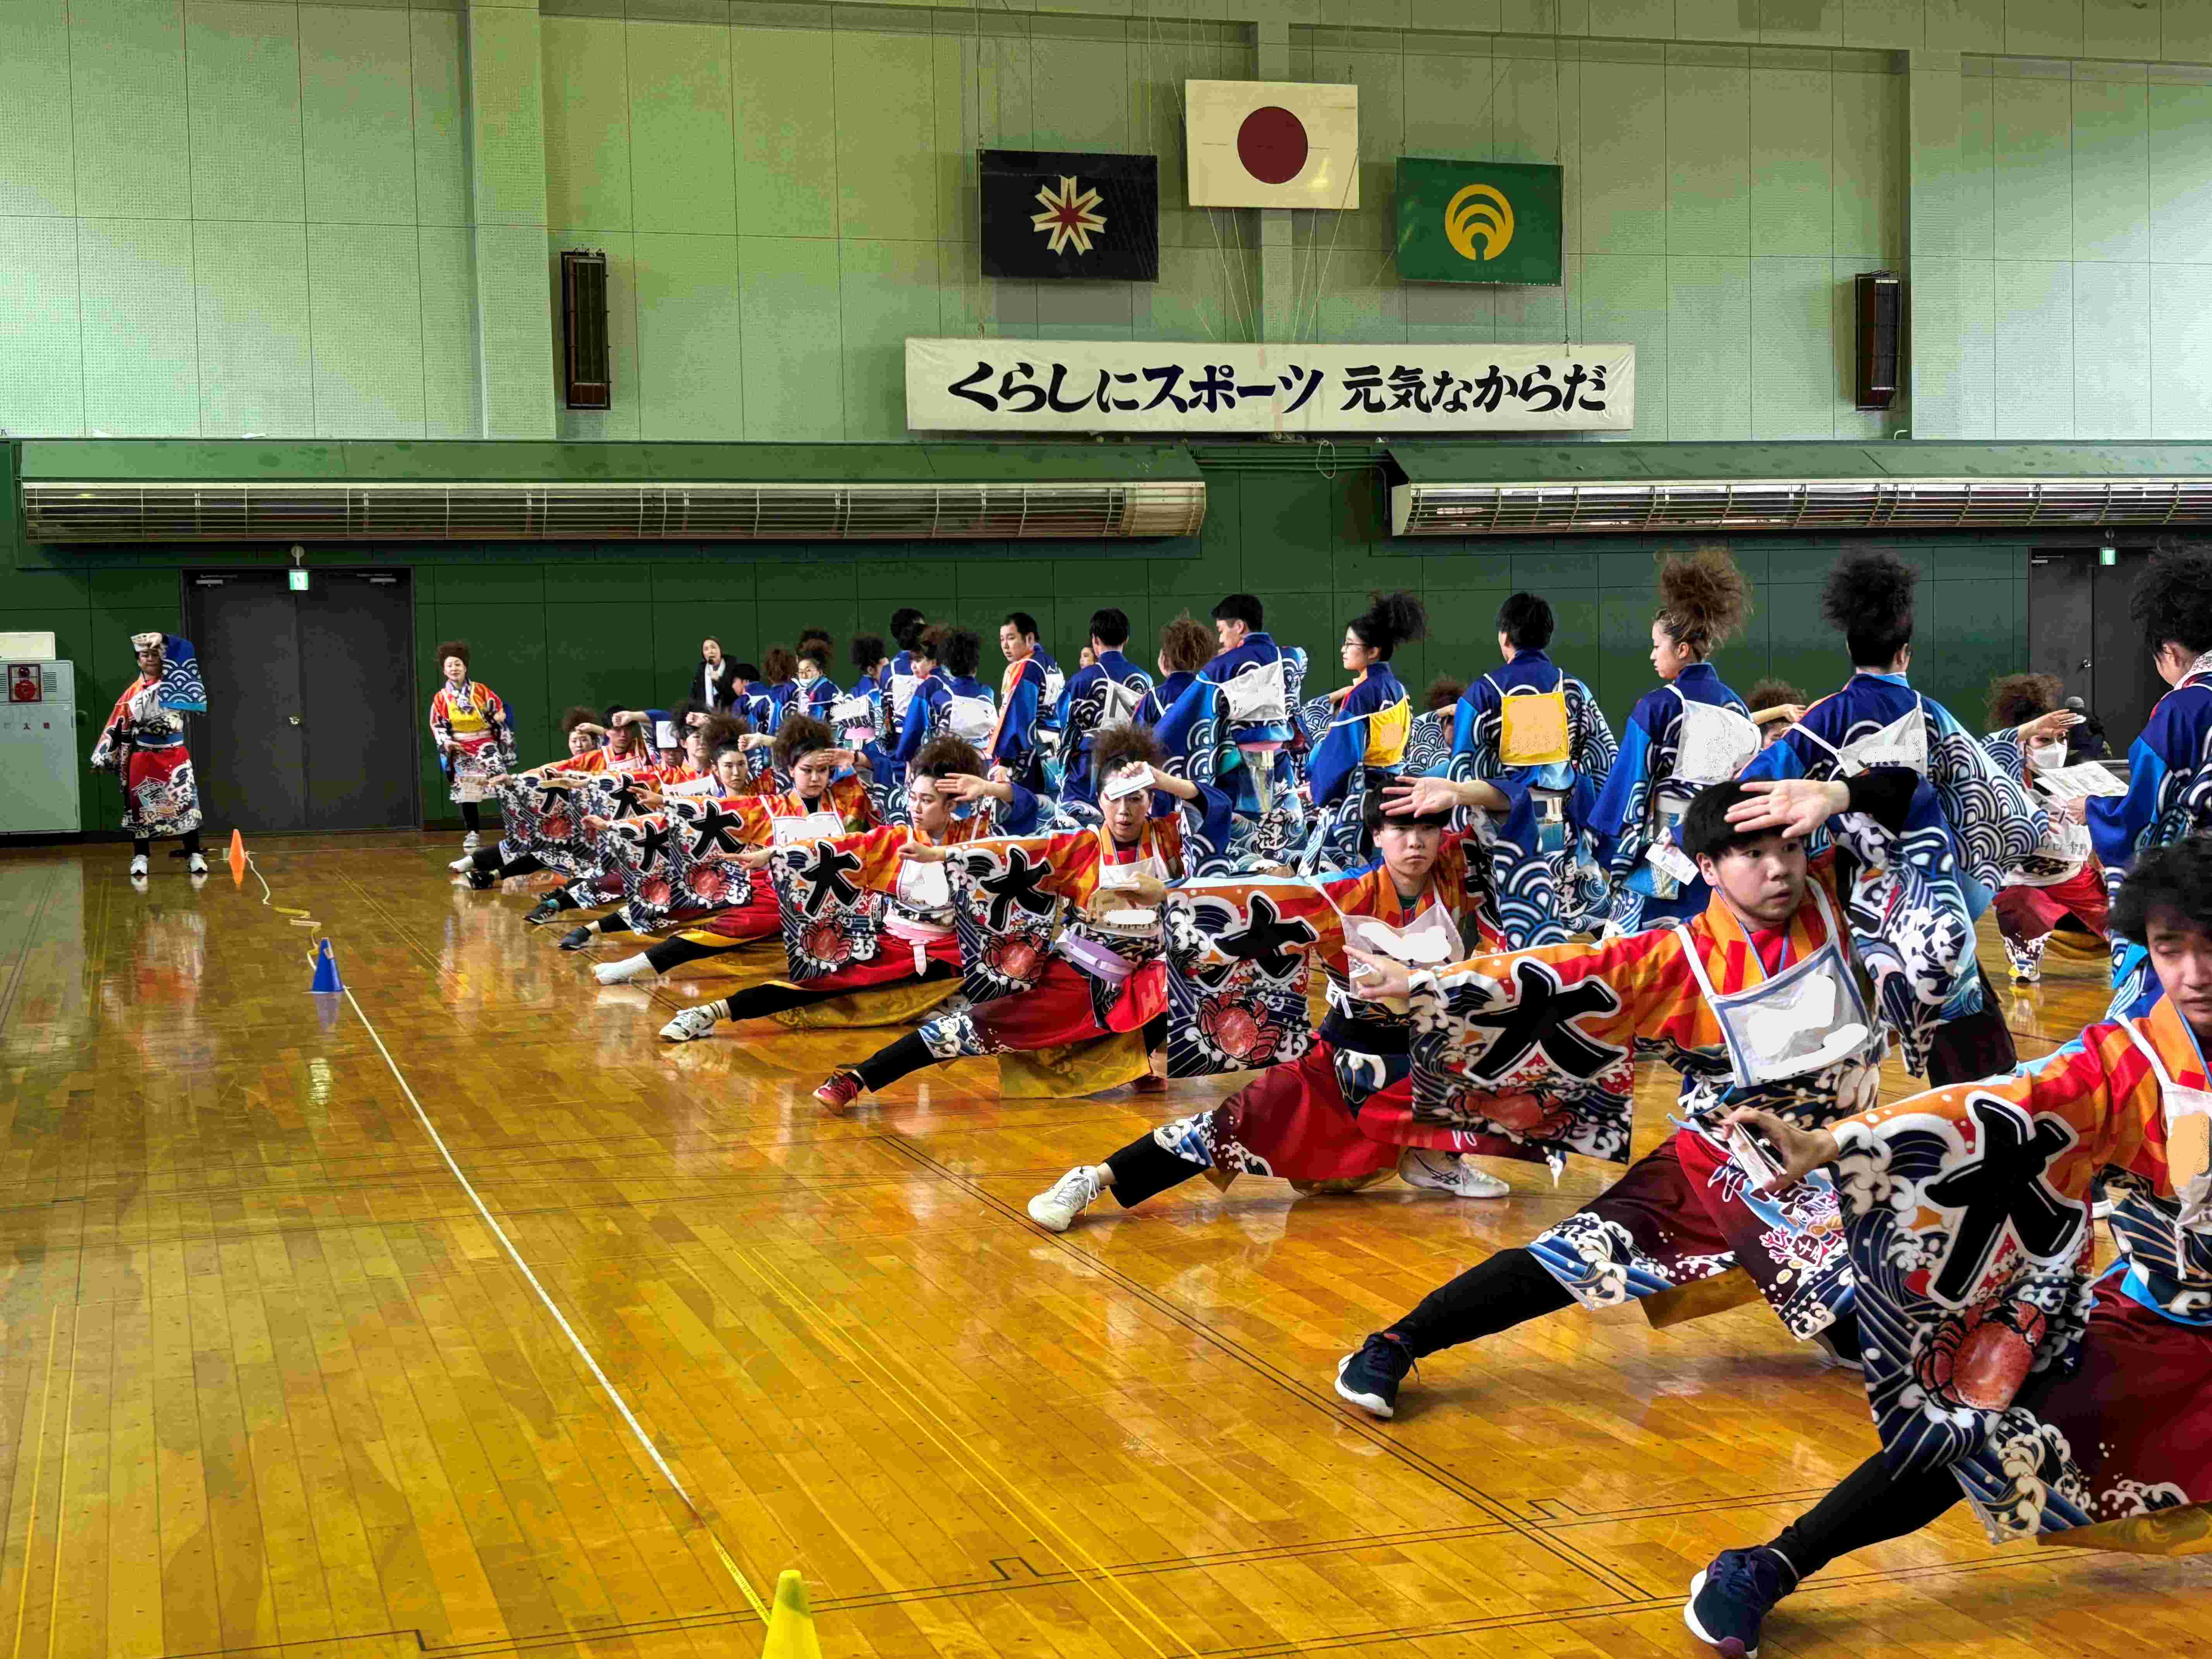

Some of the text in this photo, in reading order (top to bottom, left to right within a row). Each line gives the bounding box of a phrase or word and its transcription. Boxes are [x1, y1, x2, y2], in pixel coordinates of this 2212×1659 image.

[947, 361, 1607, 414] くらしにスポーツ 元気なからだ
[688, 800, 746, 860] 大
[800, 841, 862, 918] 大
[980, 846, 1056, 932] 大
[1467, 960, 1625, 1082] 大
[1924, 1098, 2083, 1303] 大
